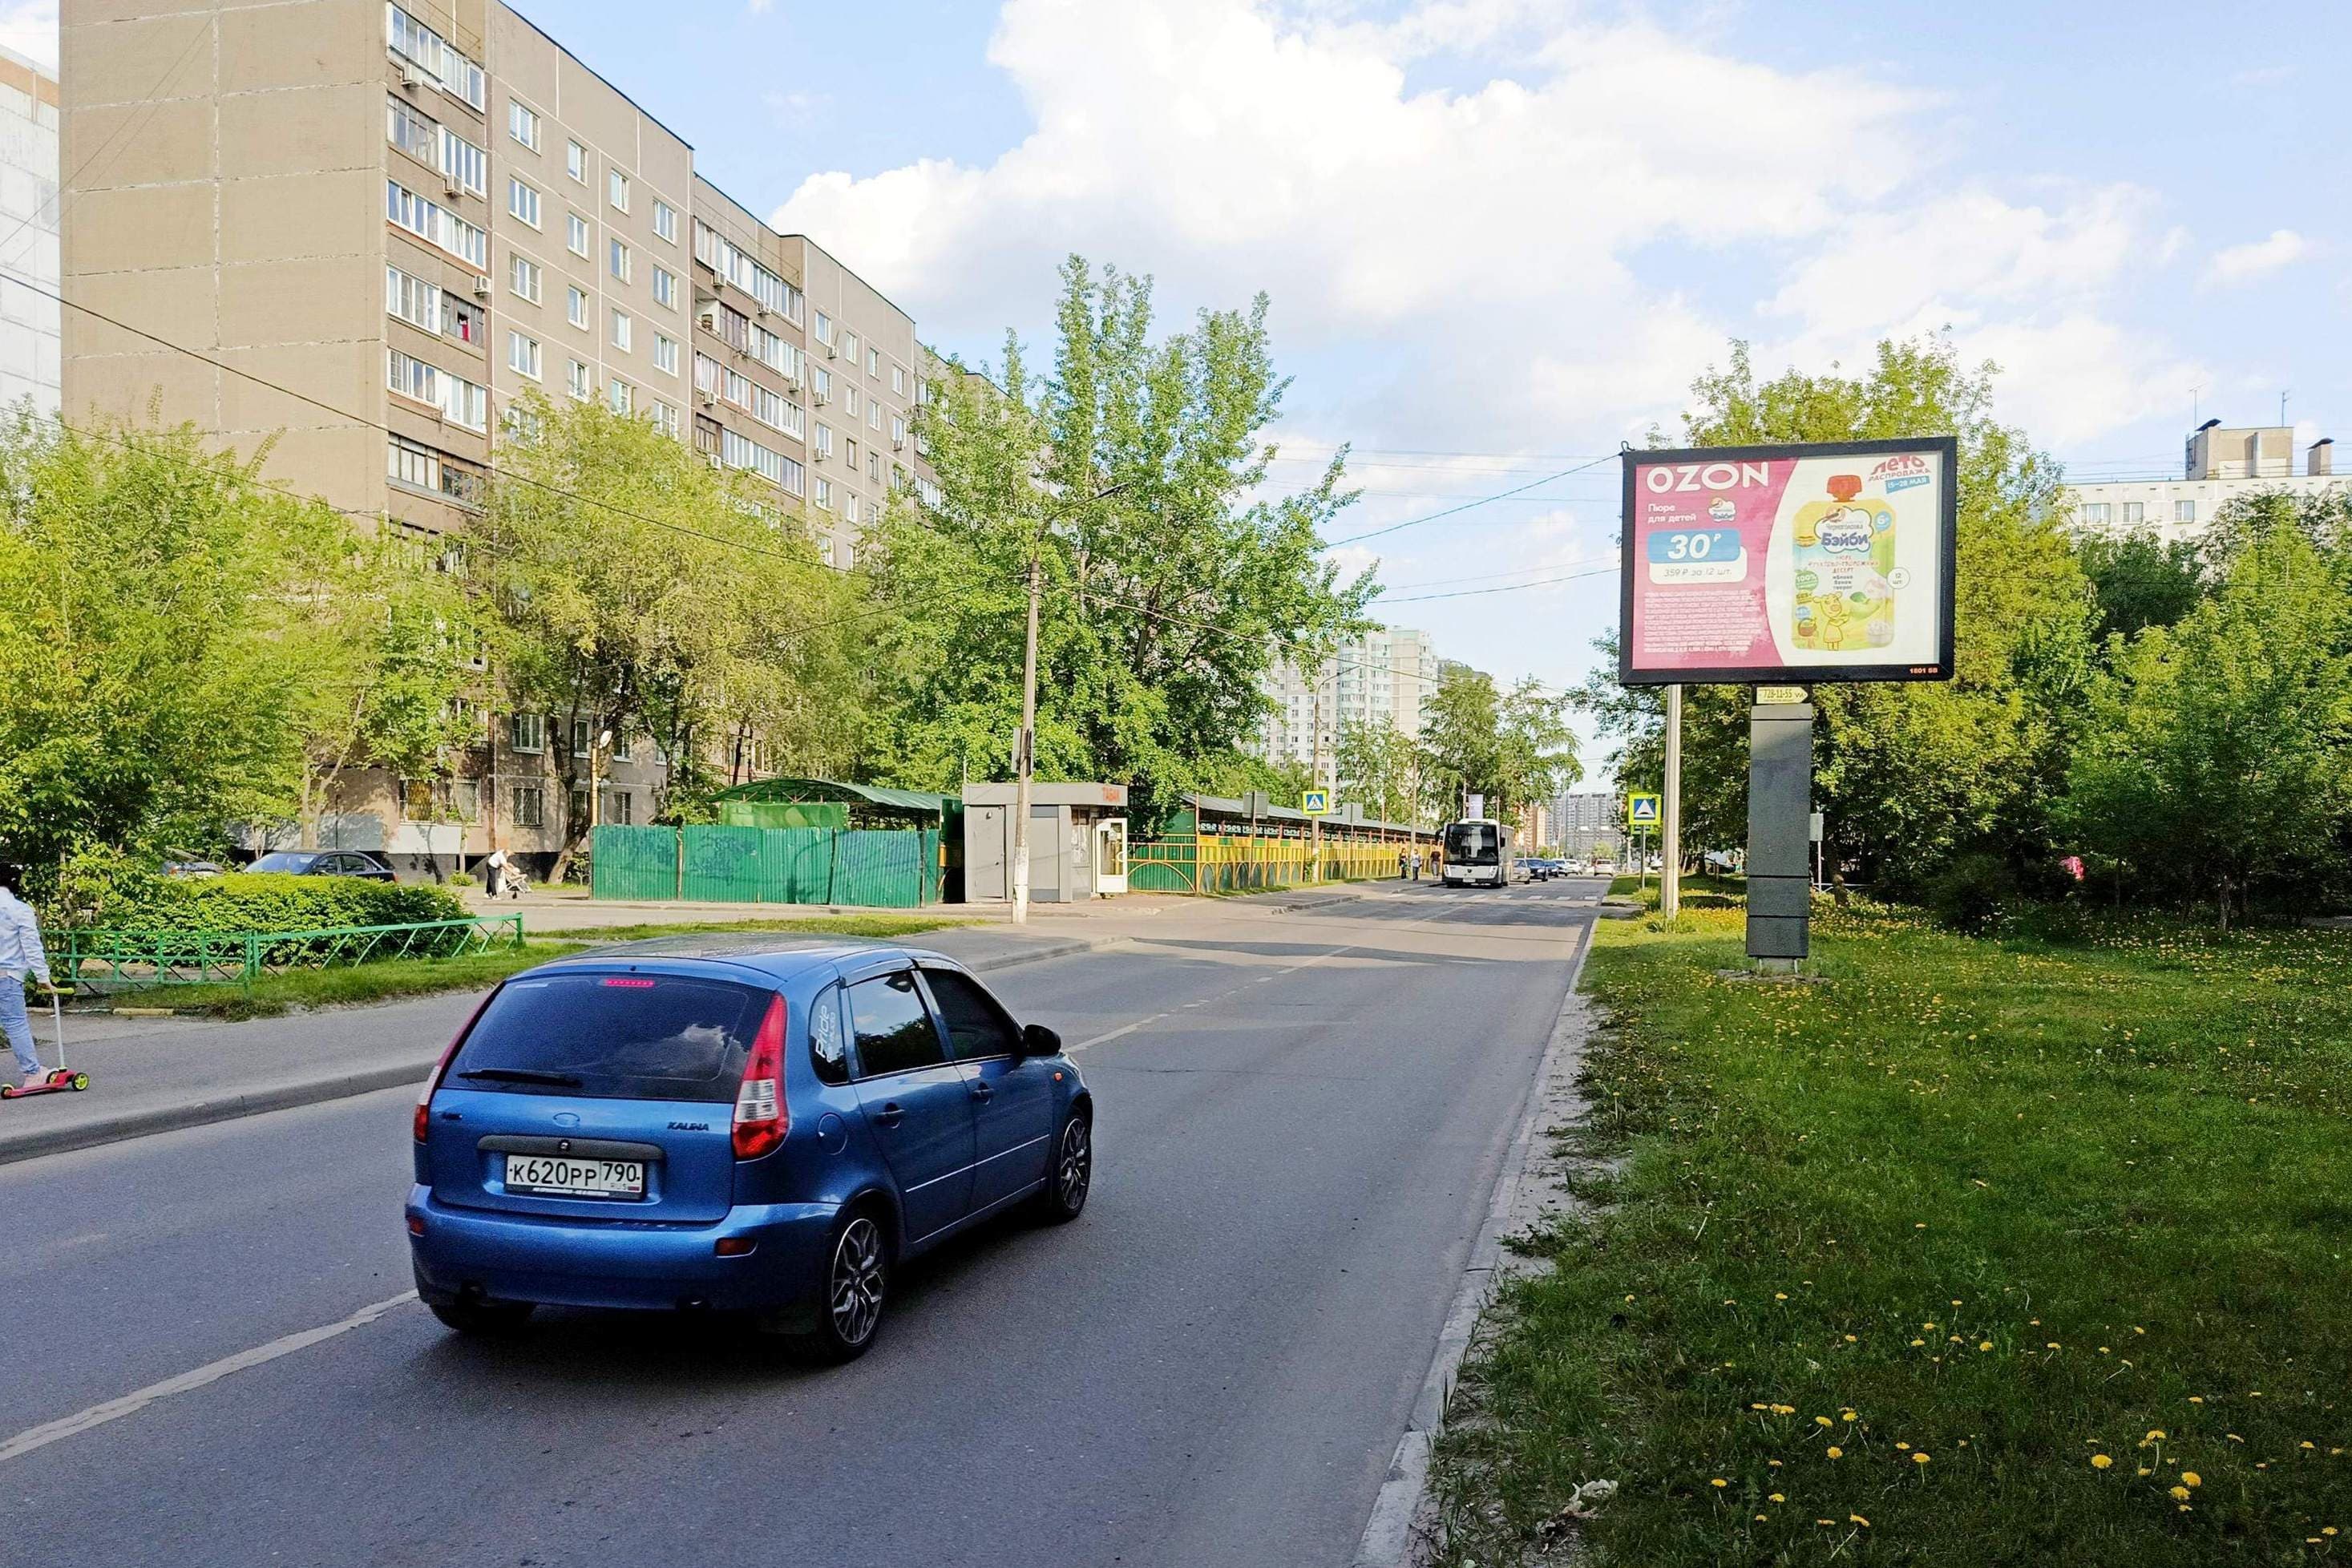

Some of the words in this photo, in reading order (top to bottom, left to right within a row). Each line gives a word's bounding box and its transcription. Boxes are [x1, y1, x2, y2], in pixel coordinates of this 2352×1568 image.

[1647, 462, 1769, 494] OZON
[1869, 468, 1931, 481] РАСПРОДАЖА
[1647, 503, 1676, 513] Пюре
[1667, 513, 1697, 523] детей
[1821, 532, 1869, 546] Бэйби
[1667, 533, 1711, 560] 30
[1663, 568, 1681, 577] 359
[1705, 568, 1715, 576] 12
[667, 1121, 709, 1131] KALINA
